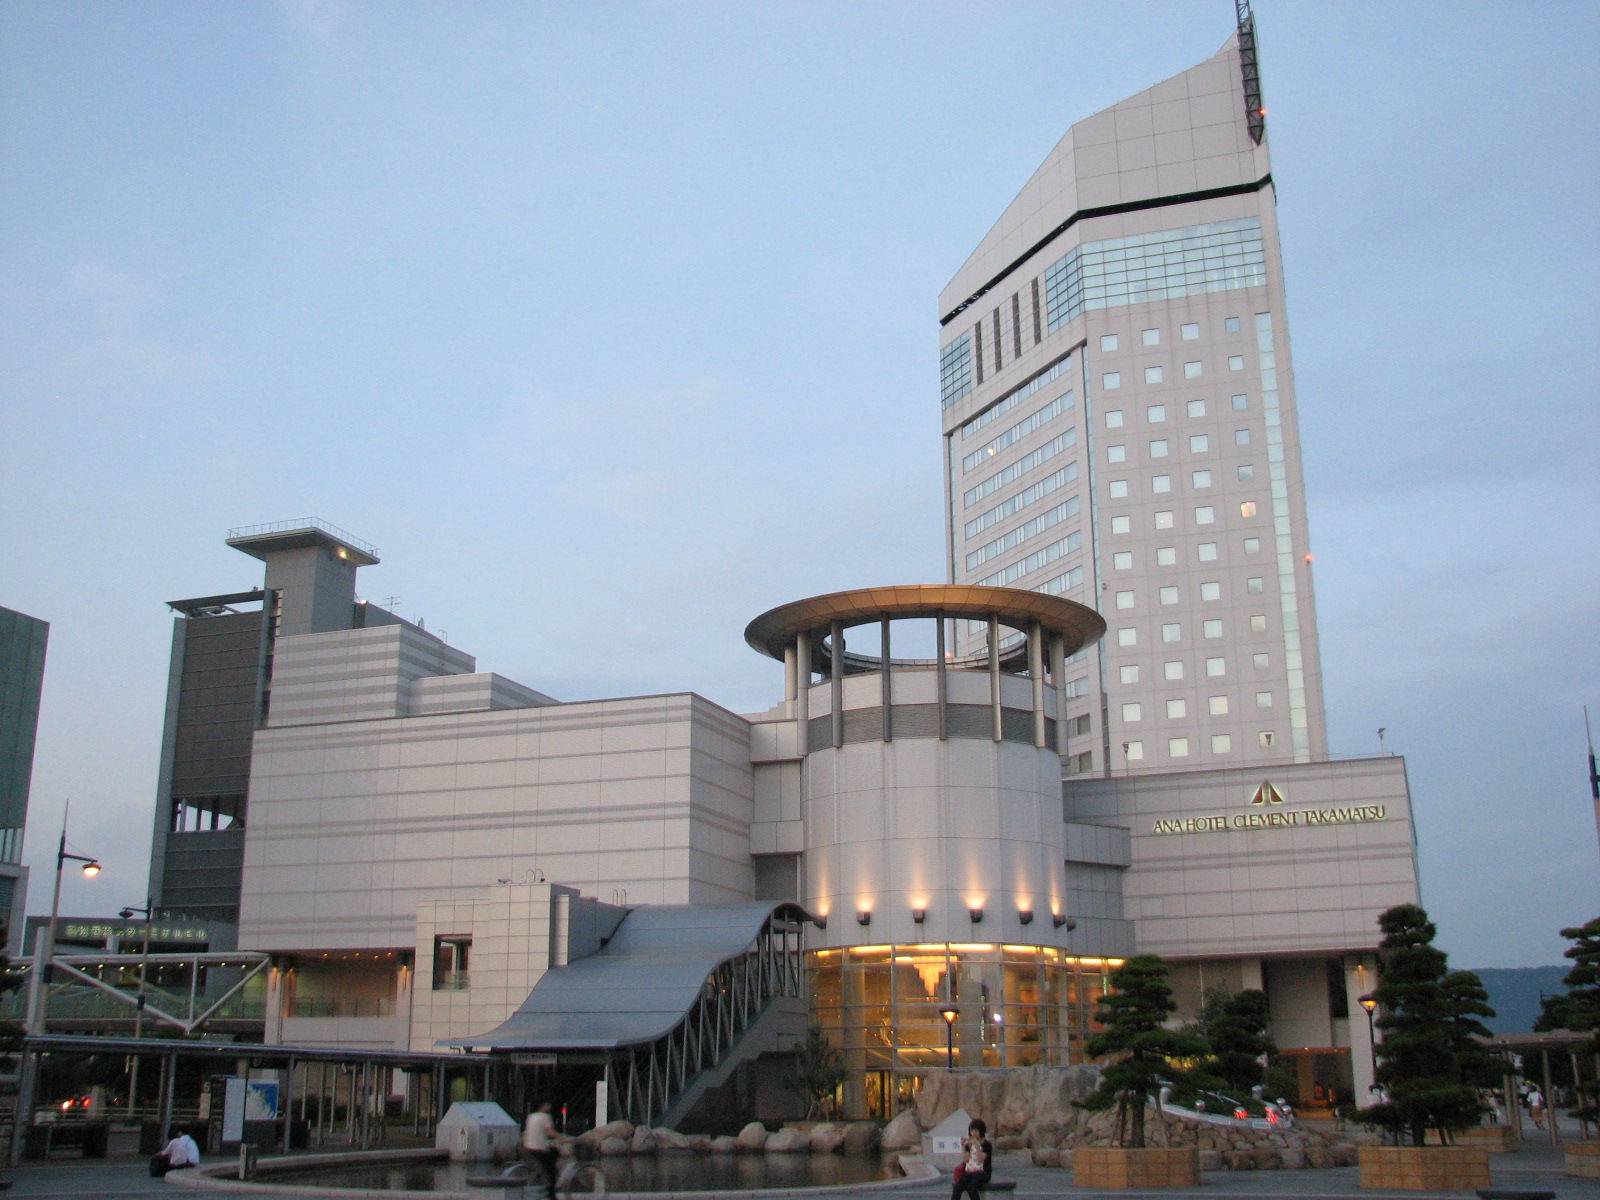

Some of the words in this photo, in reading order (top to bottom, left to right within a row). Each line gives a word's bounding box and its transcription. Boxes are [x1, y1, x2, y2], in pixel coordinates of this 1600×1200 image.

[1153, 818, 1184, 833] ANA
[1185, 816, 1230, 832] HOTEL
[1233, 811, 1300, 828] CLEMENT
[1302, 805, 1386, 823] TAKAMATSU
